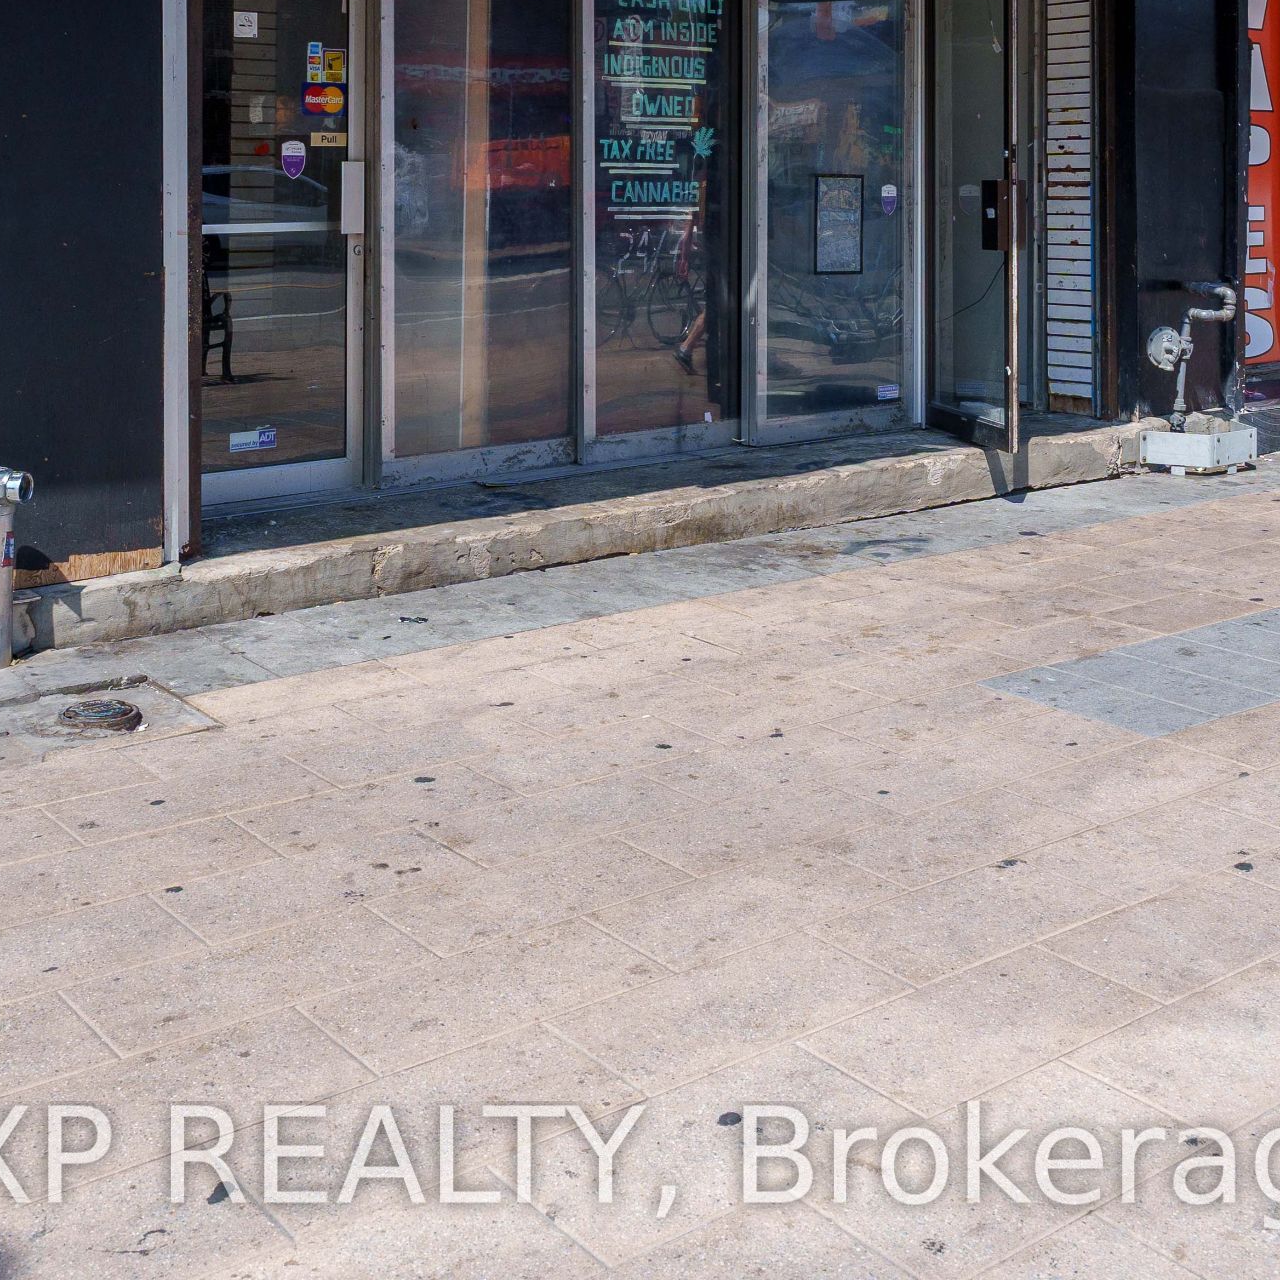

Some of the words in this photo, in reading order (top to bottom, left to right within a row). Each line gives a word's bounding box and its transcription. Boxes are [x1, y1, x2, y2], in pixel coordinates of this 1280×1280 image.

[613, 18, 654, 40] ATM
[661, 22, 718, 43] INSIDE
[604, 53, 706, 78] INDIGENOUS
[304, 94, 344, 105] MasterCard
[631, 93, 695, 117] OWNED
[320, 135, 337, 145] Pull
[600, 139, 633, 160] TAX
[636, 140, 675, 161] FREE
[611, 180, 700, 203] CANNABIS
[260, 431, 276, 442] ADT
